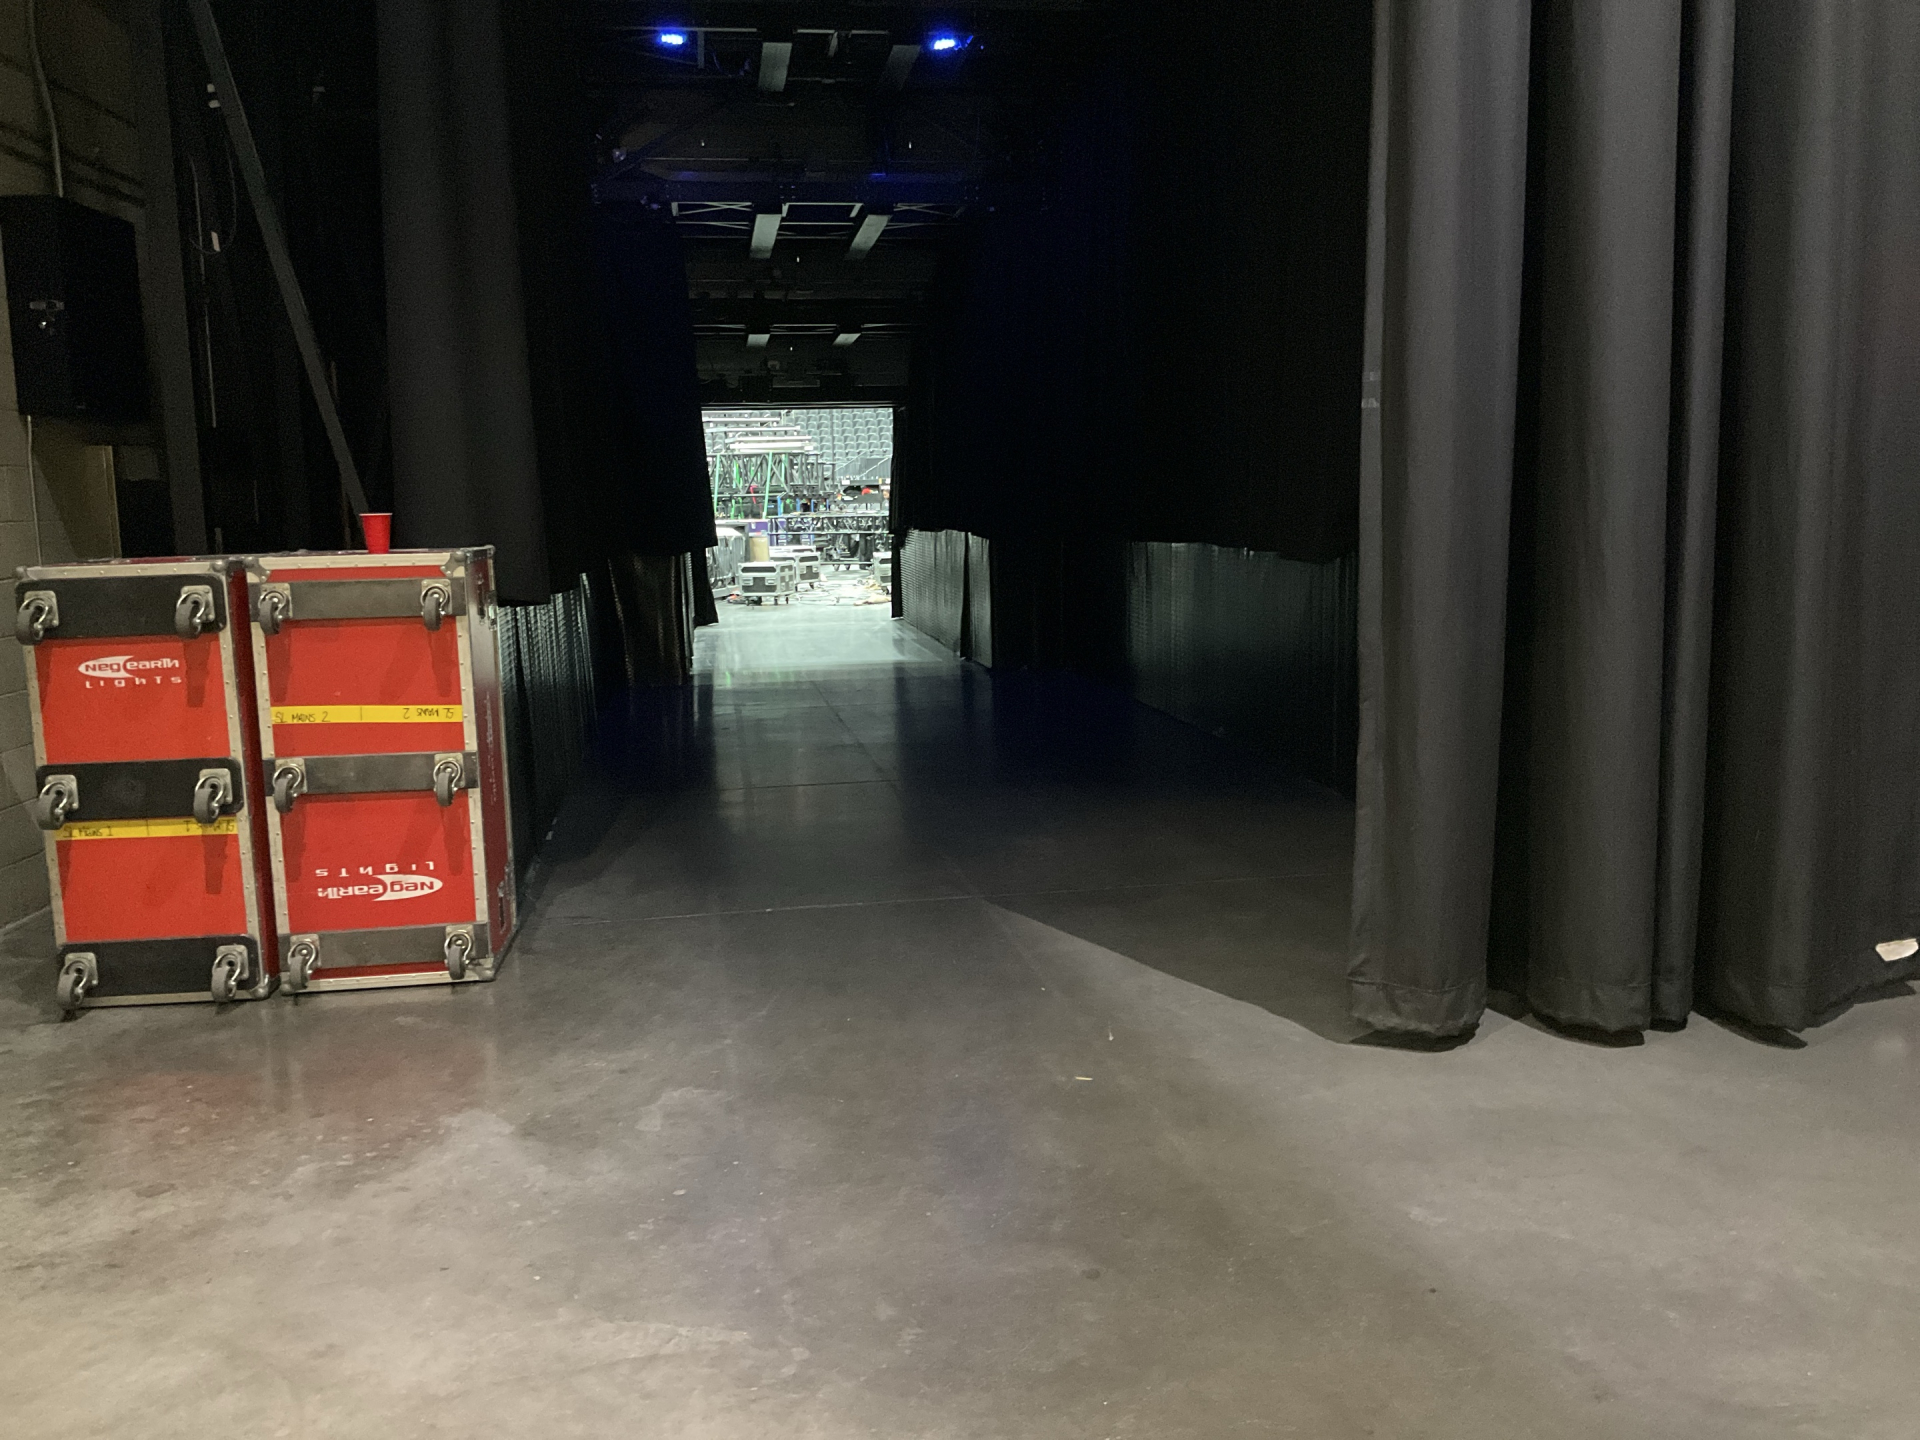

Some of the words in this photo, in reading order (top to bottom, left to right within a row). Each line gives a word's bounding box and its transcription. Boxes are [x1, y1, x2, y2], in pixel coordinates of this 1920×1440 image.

[84, 662, 122, 673] Neg
[321, 710, 332, 723] 2
[402, 707, 411, 720] 2
[389, 880, 435, 893] Neg
